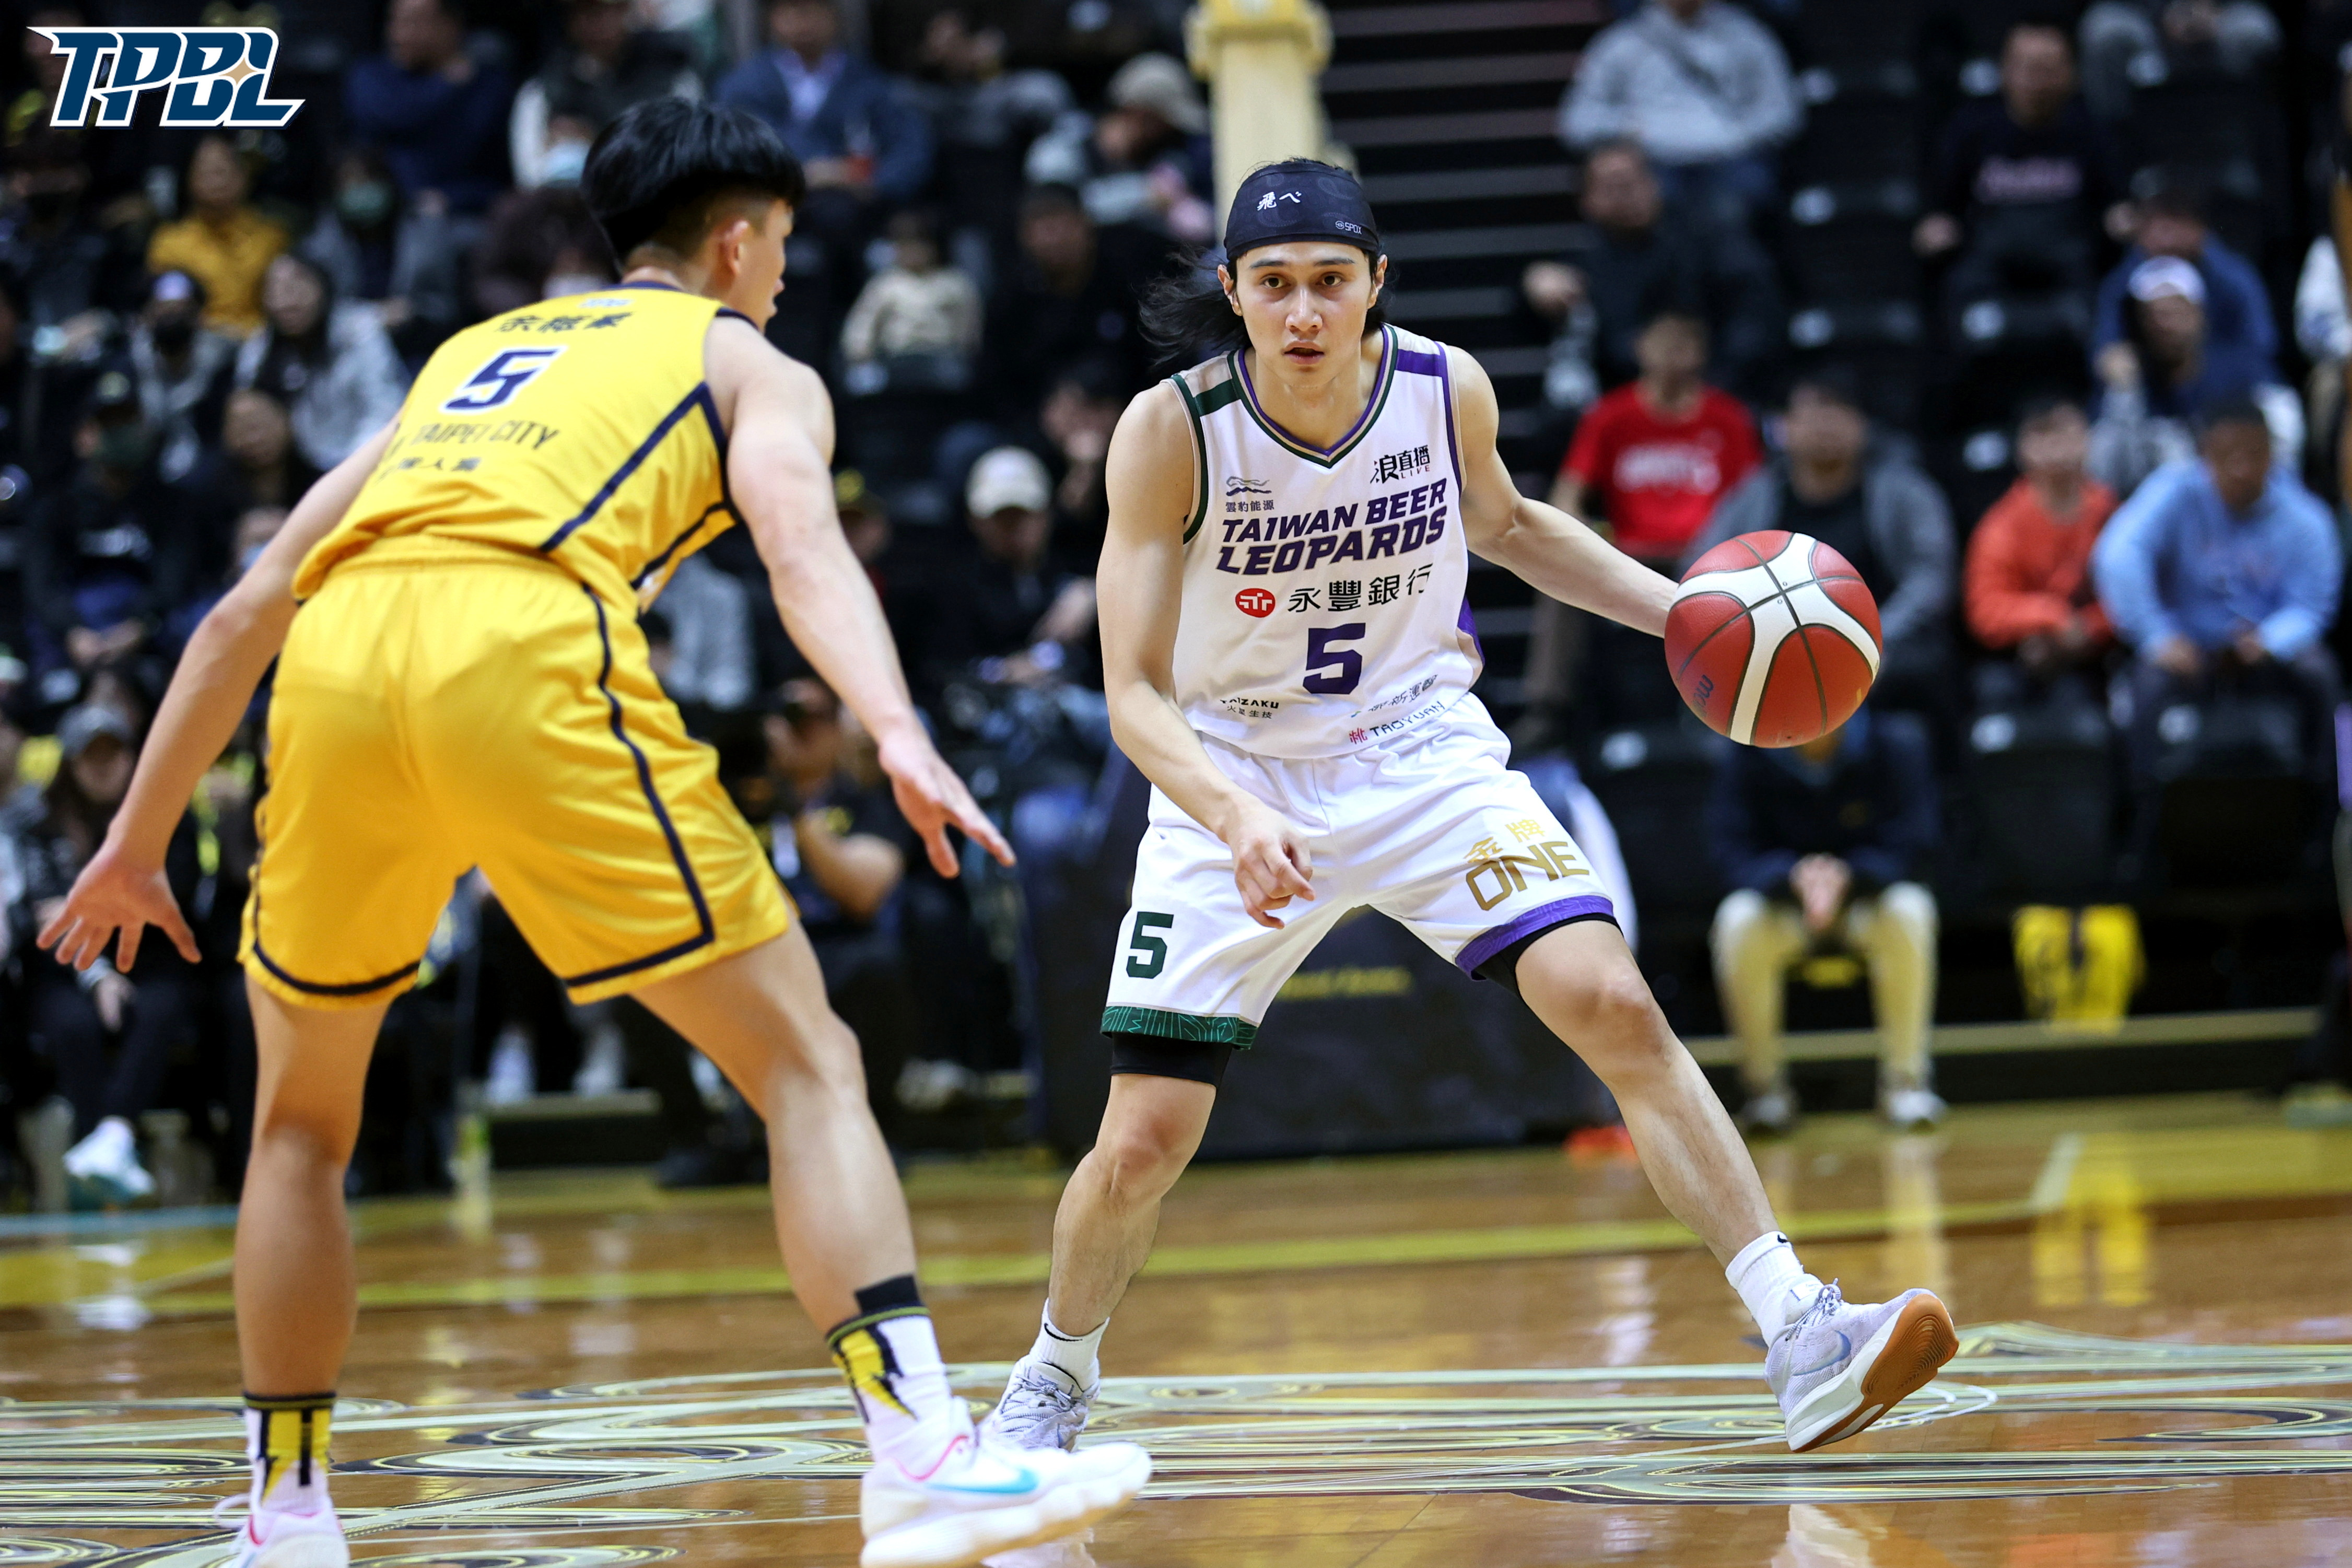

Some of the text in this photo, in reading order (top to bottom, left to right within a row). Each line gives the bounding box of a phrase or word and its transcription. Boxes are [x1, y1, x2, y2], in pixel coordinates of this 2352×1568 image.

[1257, 191, 1302, 211] 飛べ
[441, 347, 566, 411] 5
[1370, 444, 1430, 484] 浪直播
[1400, 464, 1430, 479] LIVE
[1222, 477, 1446, 542] TAIWAN BEER
[1225, 500, 1275, 513] 雲豹能源
[1216, 506, 1447, 575] LEOPARDS
[1288, 563, 1433, 613] 永豐銀行
[1303, 623, 1366, 694] 5
[1370, 700, 1445, 736] TAOYUAN
[1464, 820, 1545, 863] 金牌
[1466, 841, 1589, 911] ONE
[1126, 911, 1174, 979] 5
